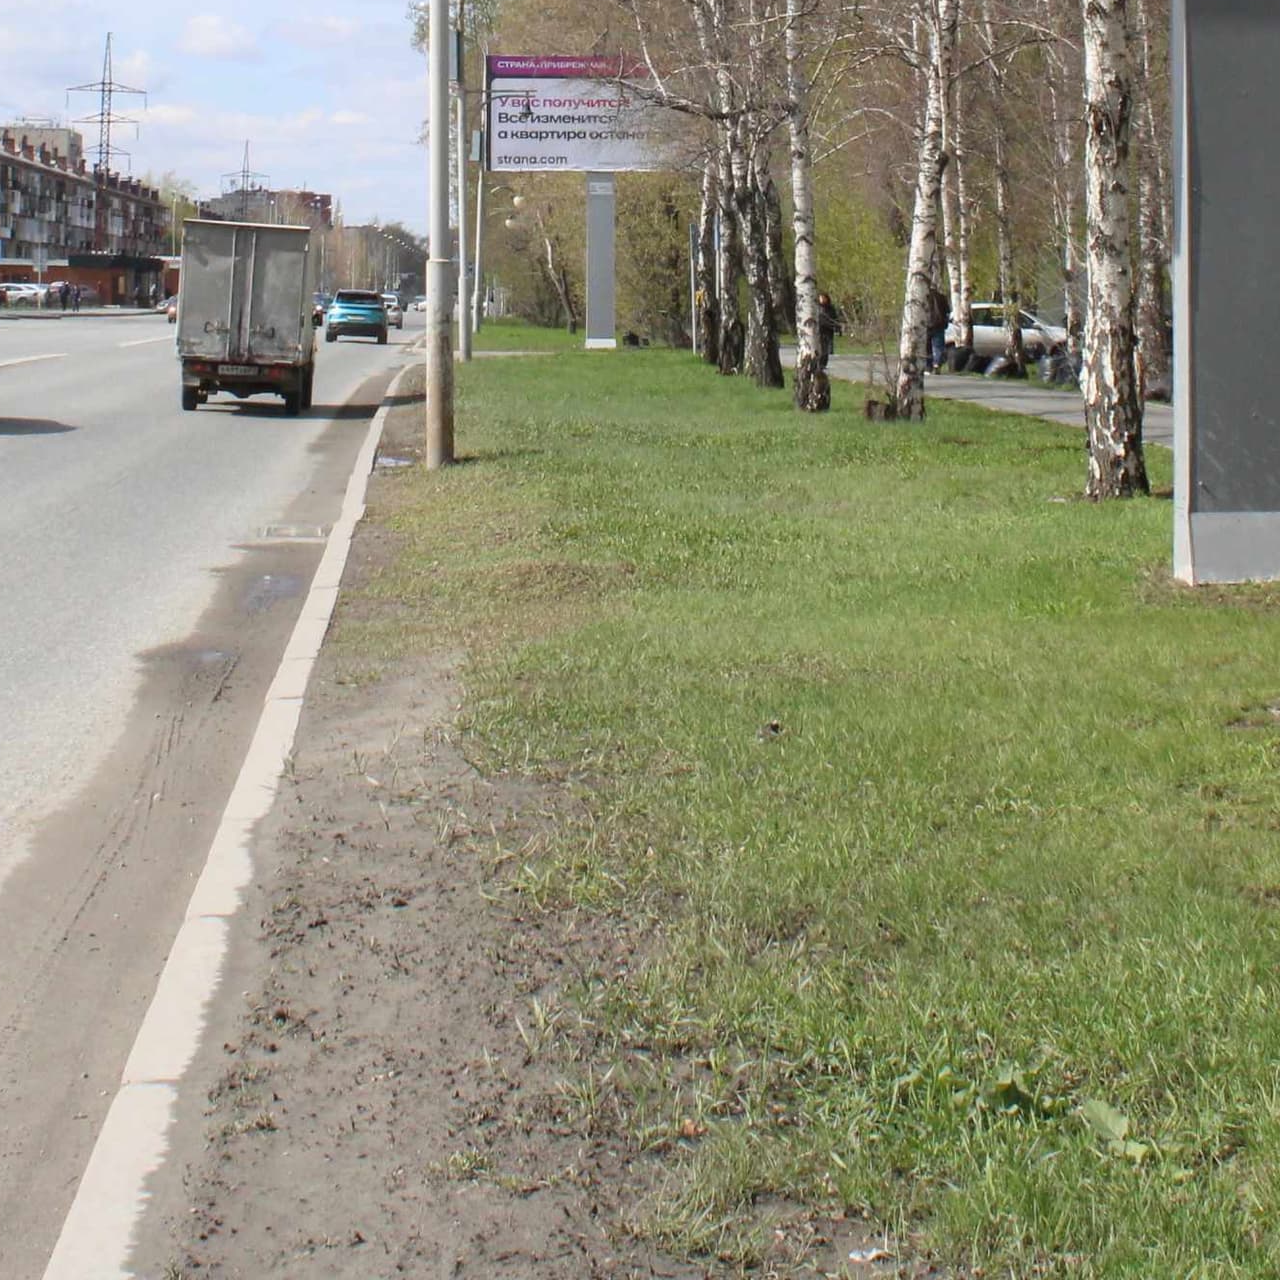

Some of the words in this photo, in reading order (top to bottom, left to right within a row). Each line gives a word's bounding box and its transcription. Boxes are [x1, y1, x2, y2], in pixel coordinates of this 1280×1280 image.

[499, 97, 510, 108] У
[511, 98, 540, 108] вас
[497, 130, 508, 139] а
[510, 130, 586, 141] квартира
[497, 154, 568, 165] strana.com
